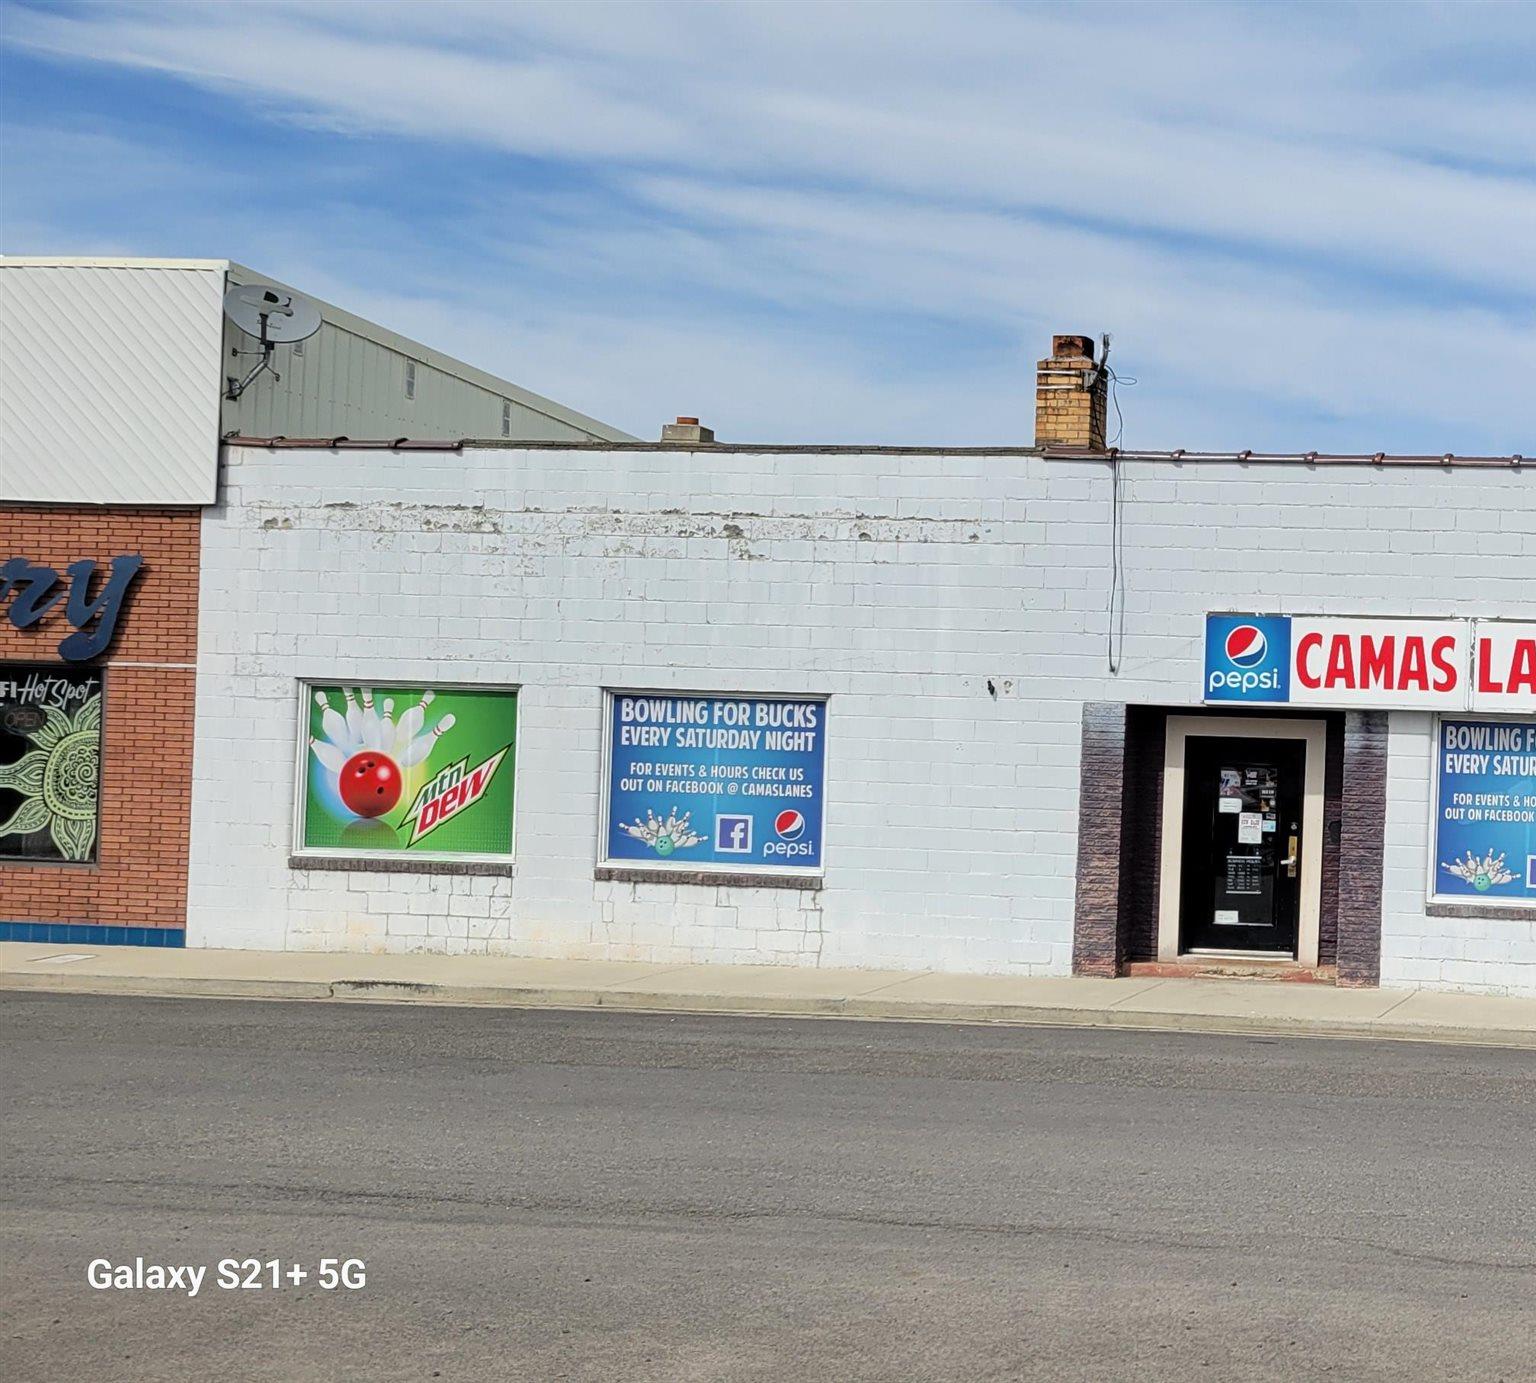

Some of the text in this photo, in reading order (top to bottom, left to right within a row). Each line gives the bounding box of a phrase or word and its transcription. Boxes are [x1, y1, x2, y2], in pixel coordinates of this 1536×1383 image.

[1295, 632, 1458, 692] CAMAS
[1208, 667, 1281, 693] pepsi
[621, 698, 817, 729] BOWLING FOR BUCKS
[621, 726, 816, 752] EVERY SATURDAY NIGHT
[1446, 726, 1522, 752] BOWLING
[630, 762, 804, 781] FOR EVENTS & HOURS CHECK US
[1446, 754, 1490, 775] EVERY
[621, 778, 813, 798] OUT ON FACEBOOK @ CAMASLANES
[1453, 793, 1473, 806] FOR
[1476, 794, 1510, 807] EVENTS
[1513, 796, 1521, 807] &
[1445, 808, 1465, 820] OUT
[1468, 809, 1482, 821] ON
[1485, 809, 1535, 823] FACEBOOK
[763, 840, 814, 858] pepsi
